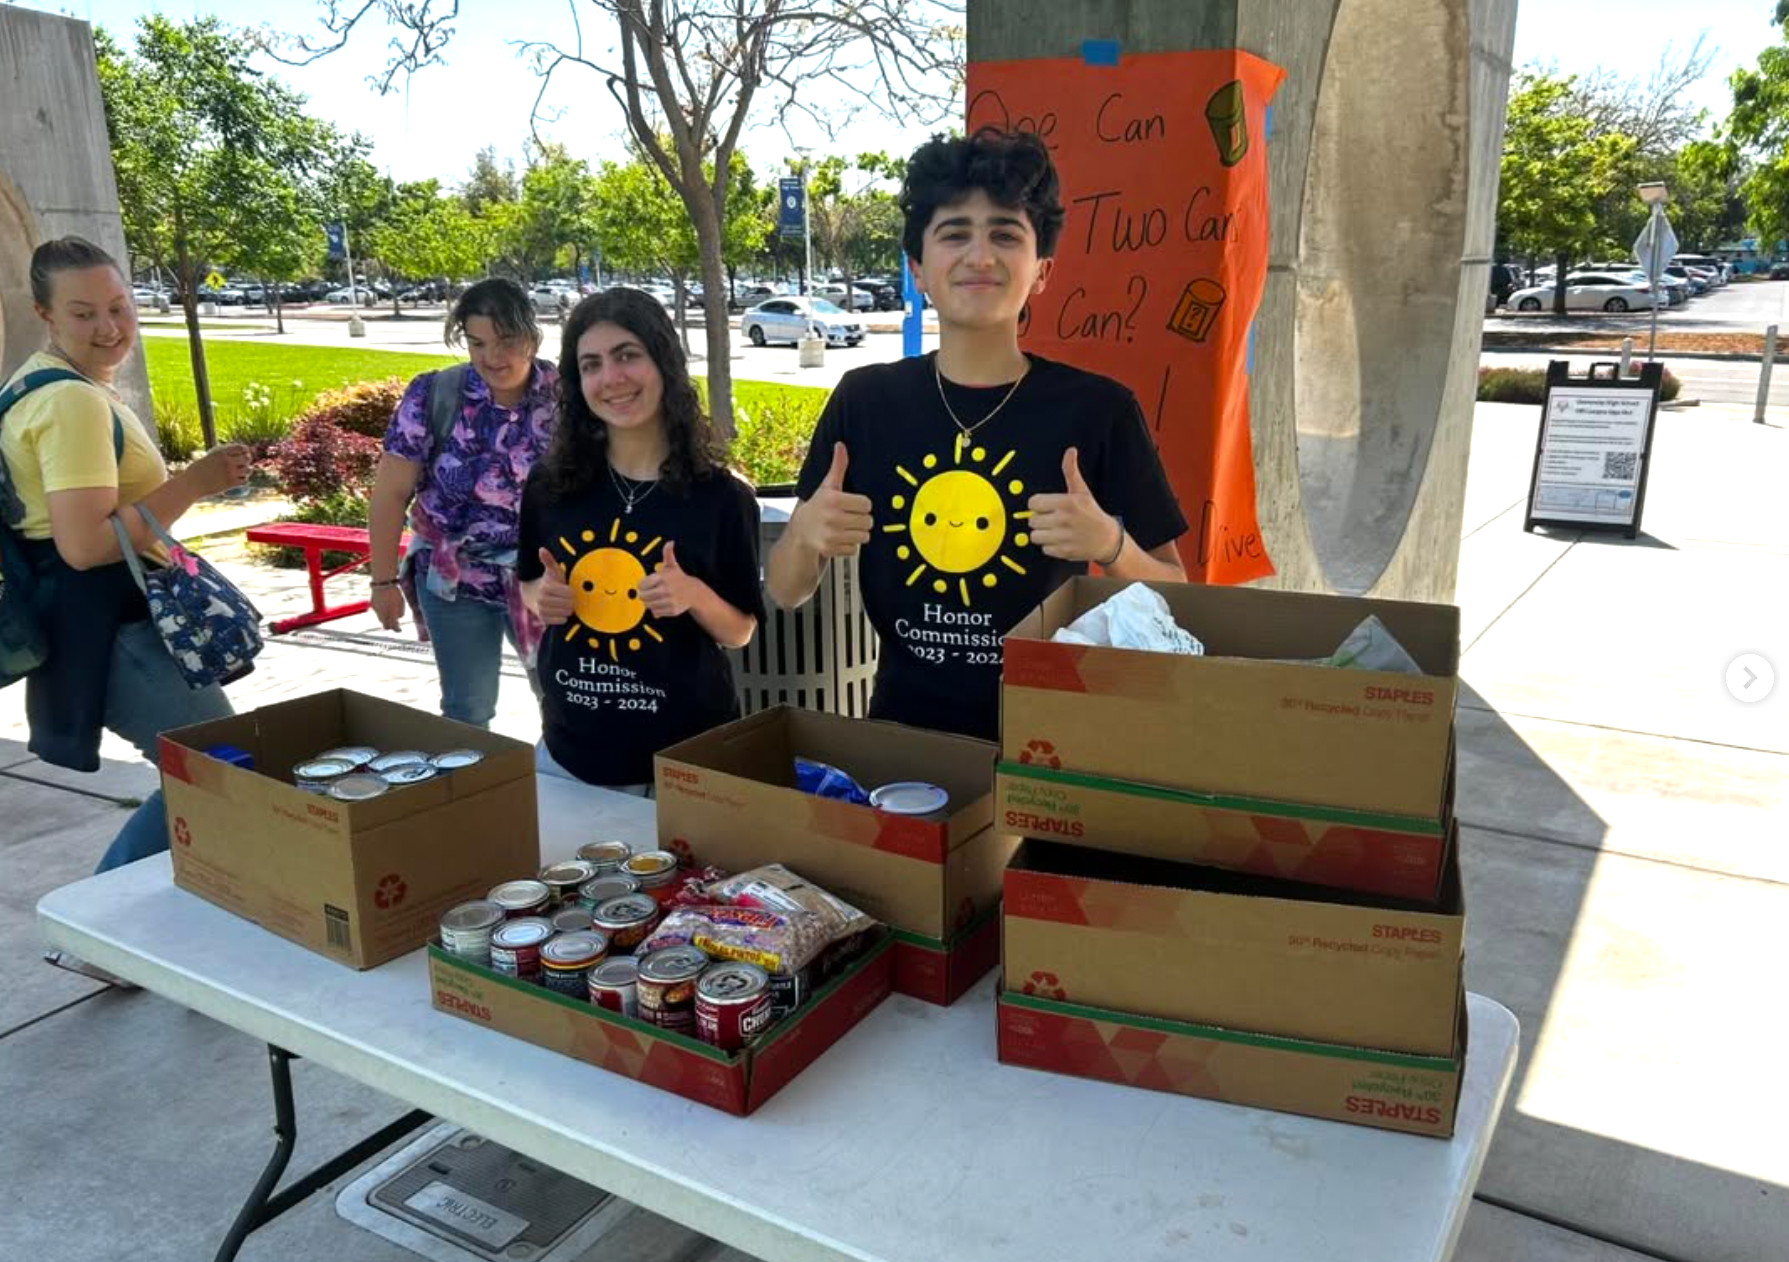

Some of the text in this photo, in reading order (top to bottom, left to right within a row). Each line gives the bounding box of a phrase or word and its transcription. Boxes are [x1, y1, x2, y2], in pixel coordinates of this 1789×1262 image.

[1096, 93, 1166, 142] Can
[1073, 186, 1239, 254] Two Can
[1057, 275, 1147, 343] Can?
[923, 602, 992, 626] Honor
[895, 618, 1006, 647] Commissio
[578, 656, 638, 680] Honor
[555, 669, 667, 698] Commission
[1364, 685, 1435, 706] STAPLES
[566, 691, 599, 710] 2023
[617, 698, 659, 713] 2024
[1005, 810, 1084, 837] STAPLES
[1372, 924, 1443, 944] STAPLES
[1345, 1096, 1441, 1125] STAPLES
[436, 1196, 499, 1231] ELECTRIC
